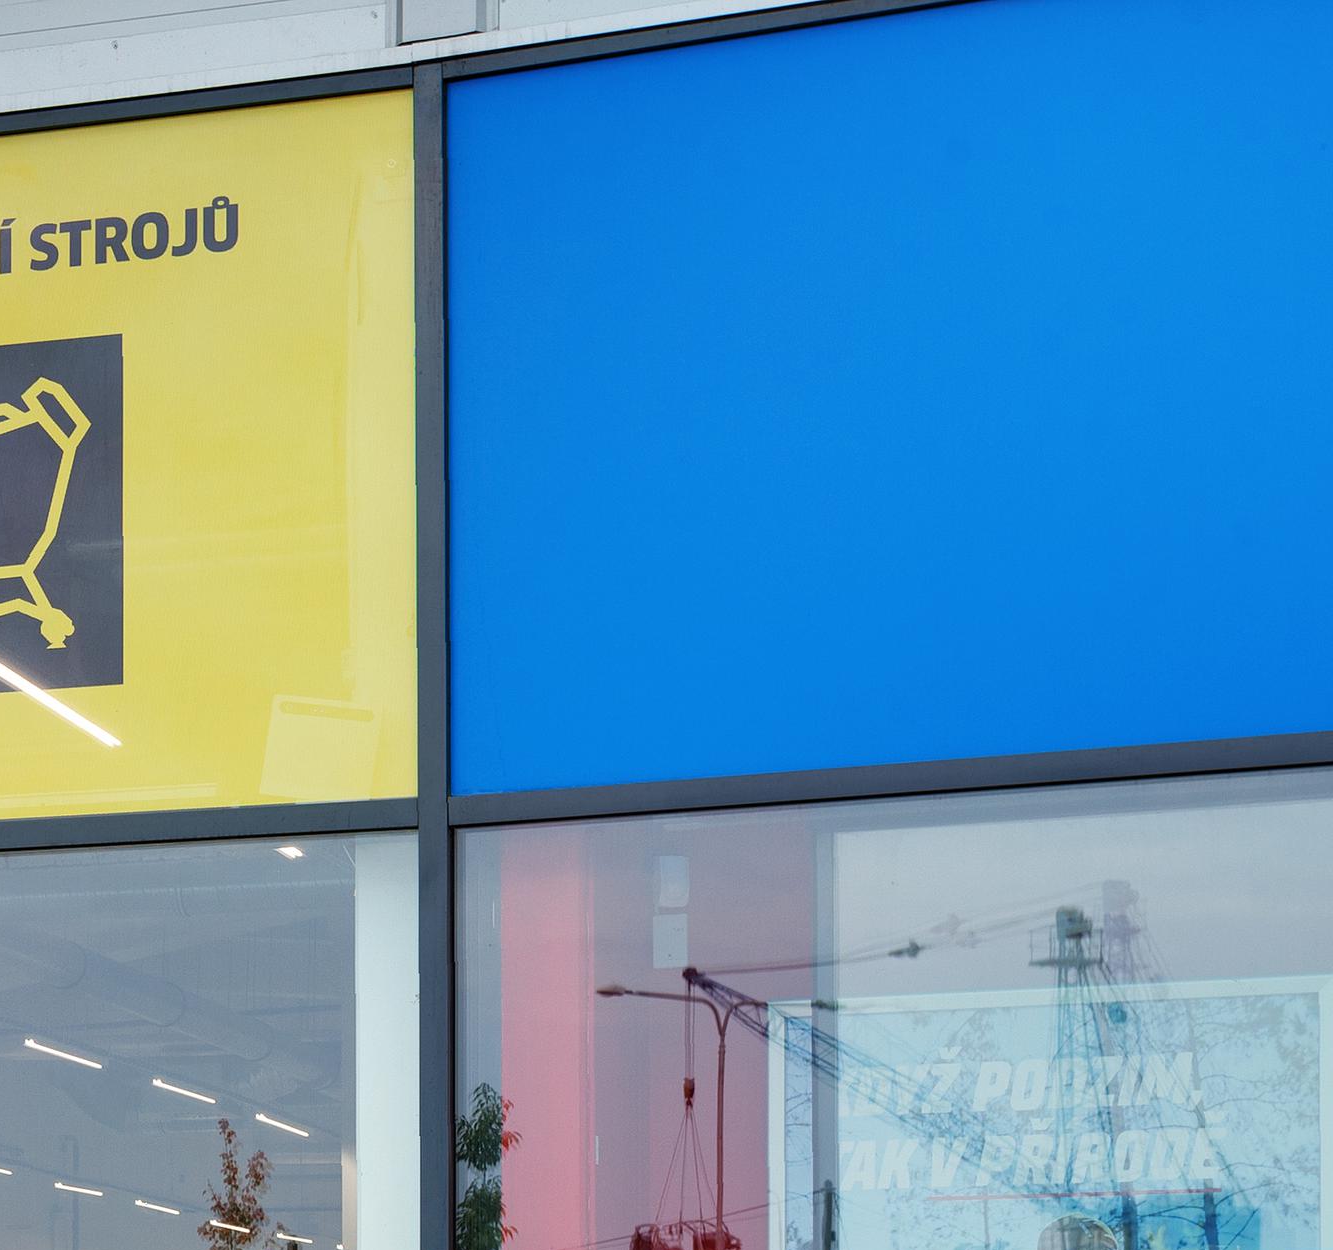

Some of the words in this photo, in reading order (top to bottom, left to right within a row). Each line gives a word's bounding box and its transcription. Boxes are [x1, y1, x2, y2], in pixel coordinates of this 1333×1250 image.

[29, 196, 240, 270] STROJŮ
[973, 1052, 1202, 1112] PODZIM,
[931, 1137, 968, 1188] V
[975, 1109, 1229, 1187] PŘÍRODĚ
